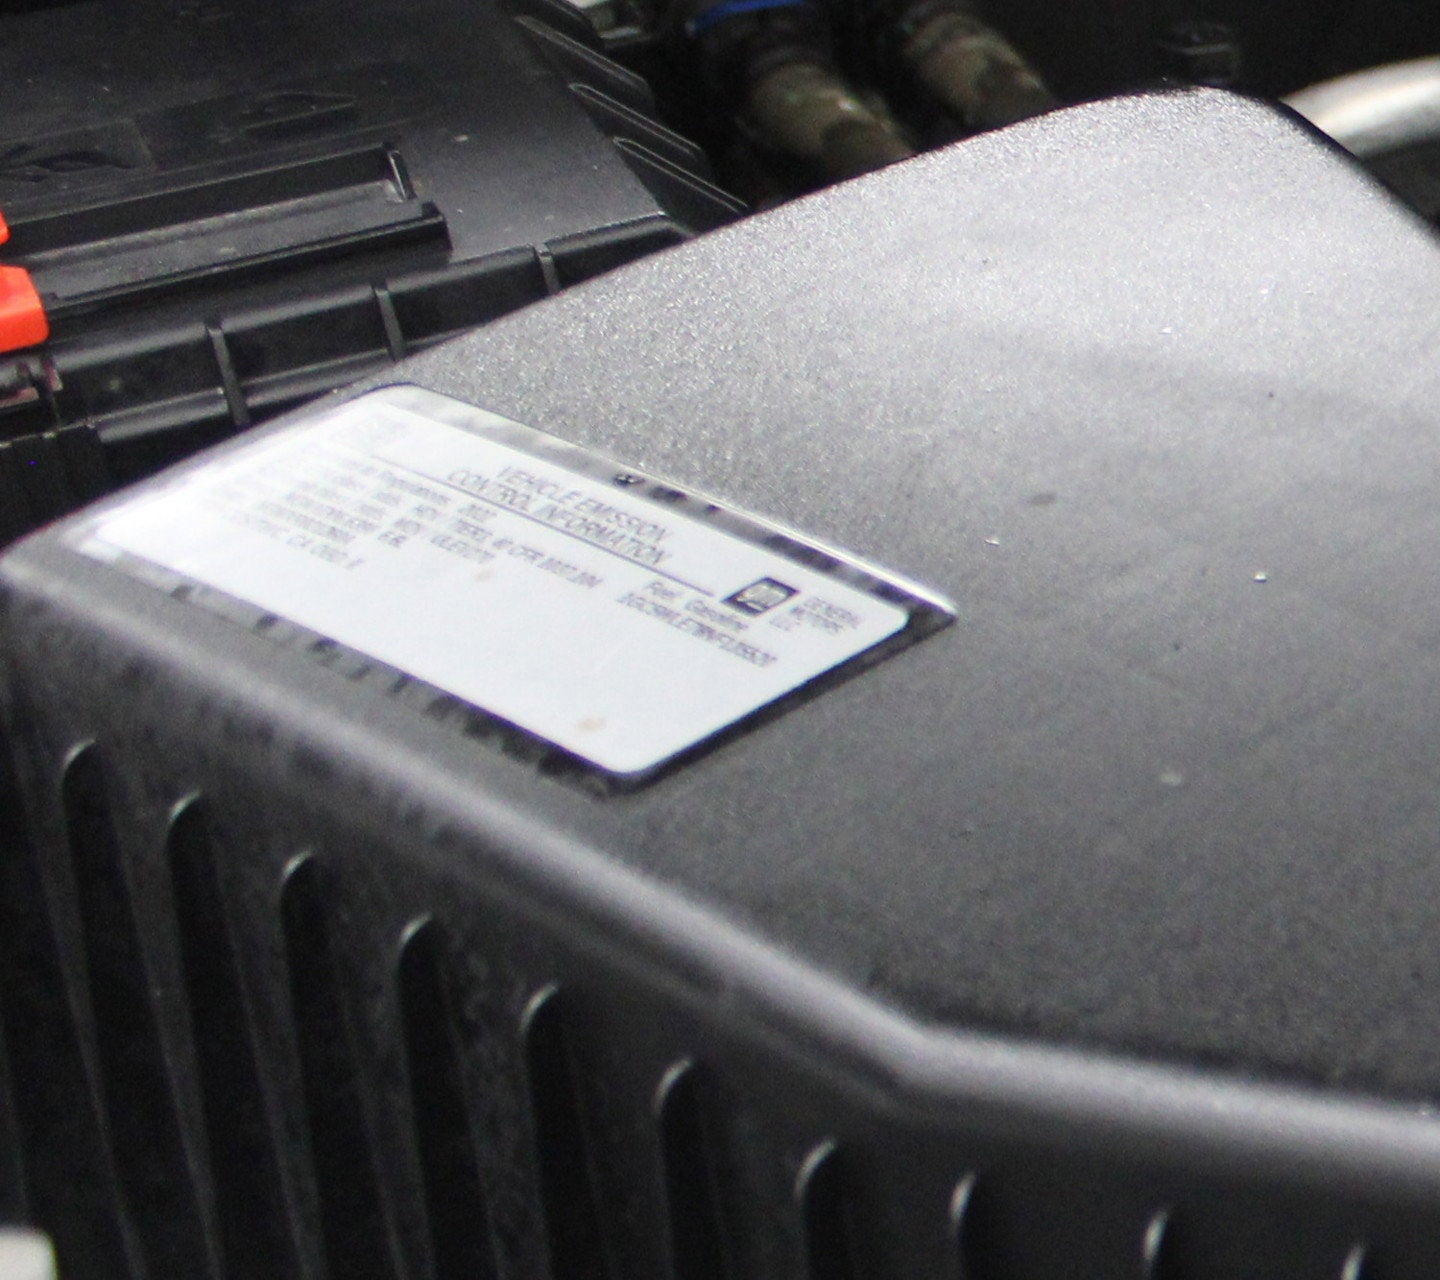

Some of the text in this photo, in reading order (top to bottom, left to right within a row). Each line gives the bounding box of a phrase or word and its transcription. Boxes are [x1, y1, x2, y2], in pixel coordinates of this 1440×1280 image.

[443, 467, 545, 511] CONTROL
[531, 503, 674, 565] INFORMATION
[493, 465, 675, 542] VEHICLE EMISSION
